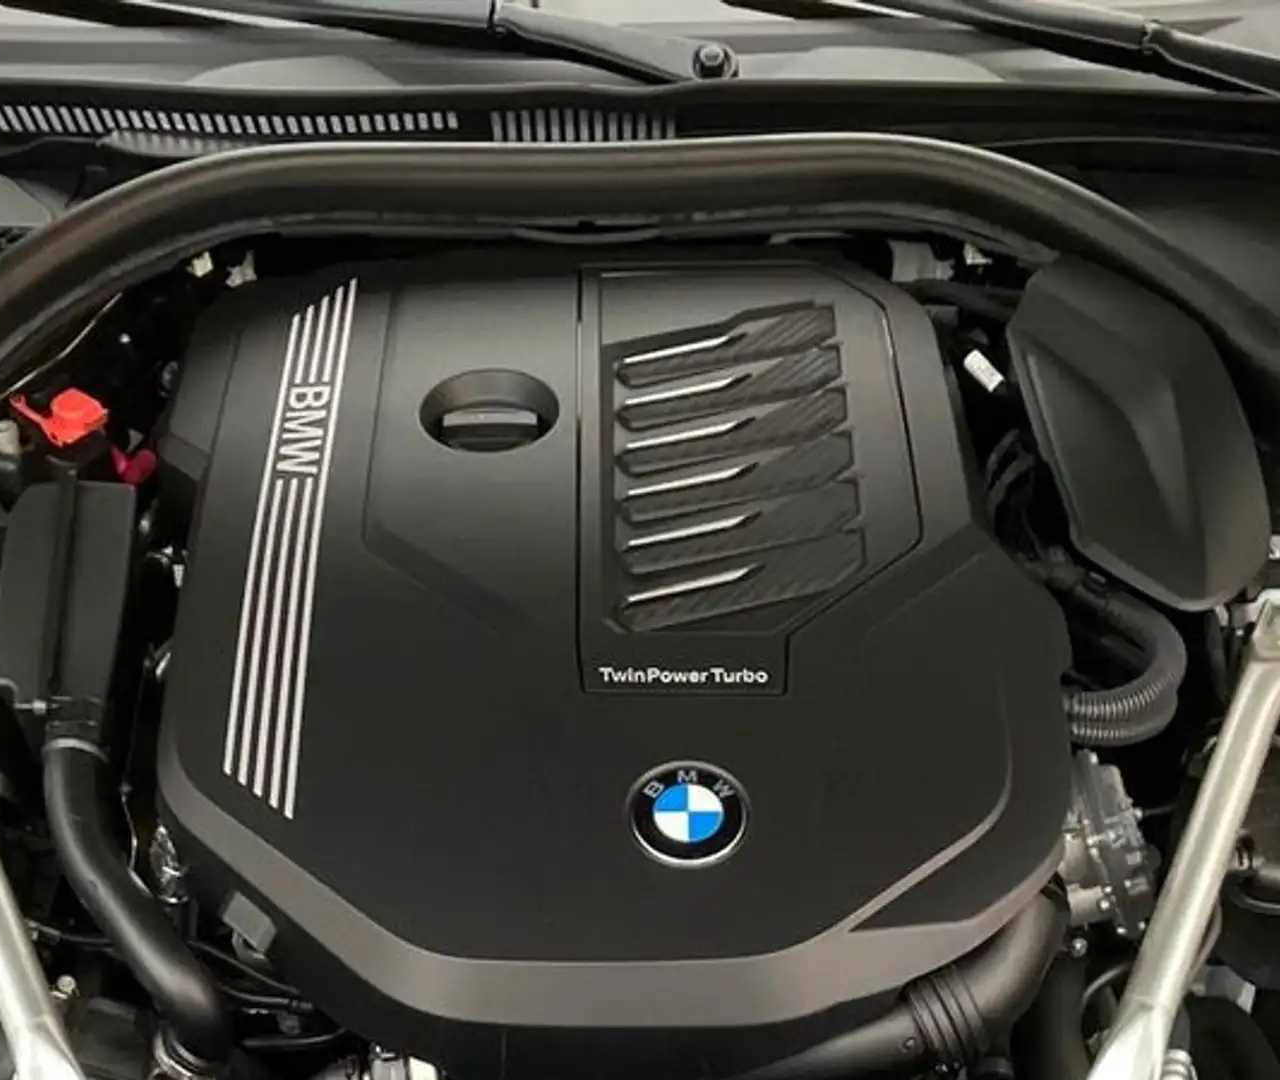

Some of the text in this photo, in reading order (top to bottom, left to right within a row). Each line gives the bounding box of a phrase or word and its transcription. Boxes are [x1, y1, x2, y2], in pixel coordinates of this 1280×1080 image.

[276, 385, 331, 475] BMW
[598, 666, 769, 683] TwinPower Turbo
[642, 768, 736, 799] BMW
